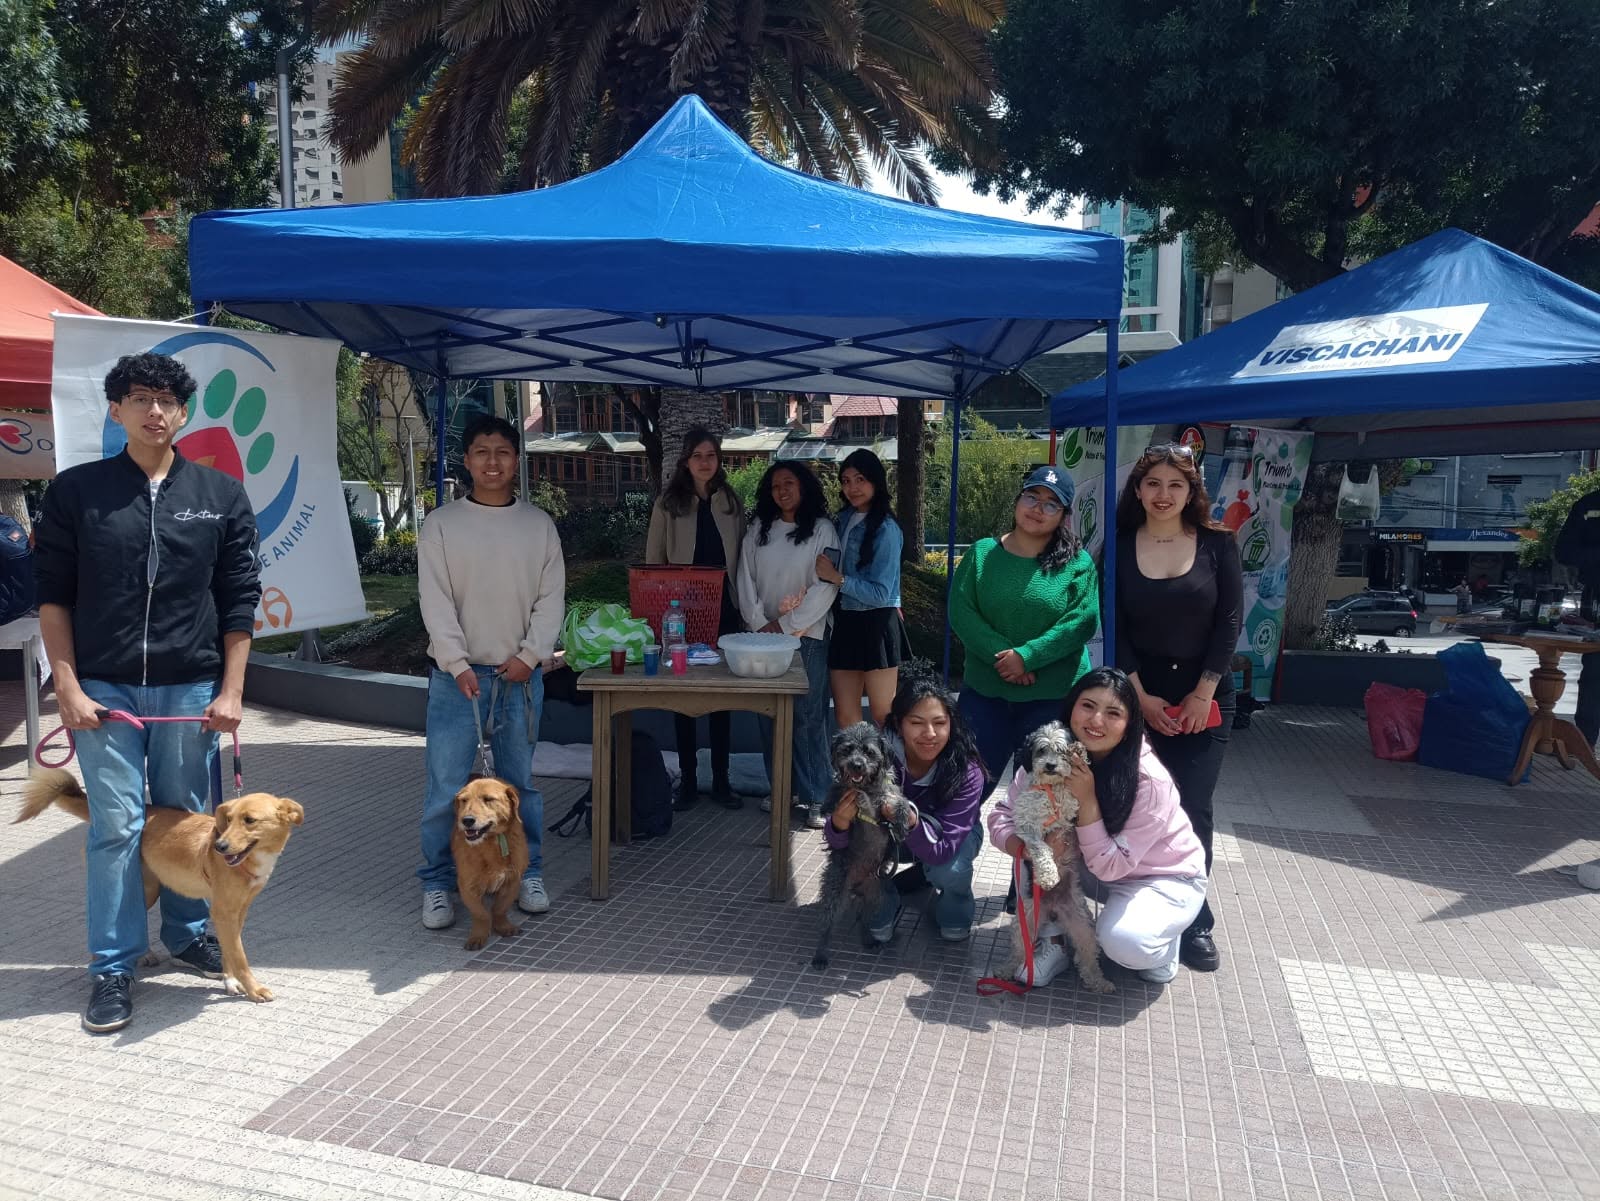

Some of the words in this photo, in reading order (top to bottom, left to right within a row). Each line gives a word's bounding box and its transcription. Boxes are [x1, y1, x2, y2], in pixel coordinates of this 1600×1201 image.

[1259, 332, 1463, 366] VISCACHANI
[1264, 461, 1293, 478] Triunfo
[272, 503, 316, 560] ANIMAL
